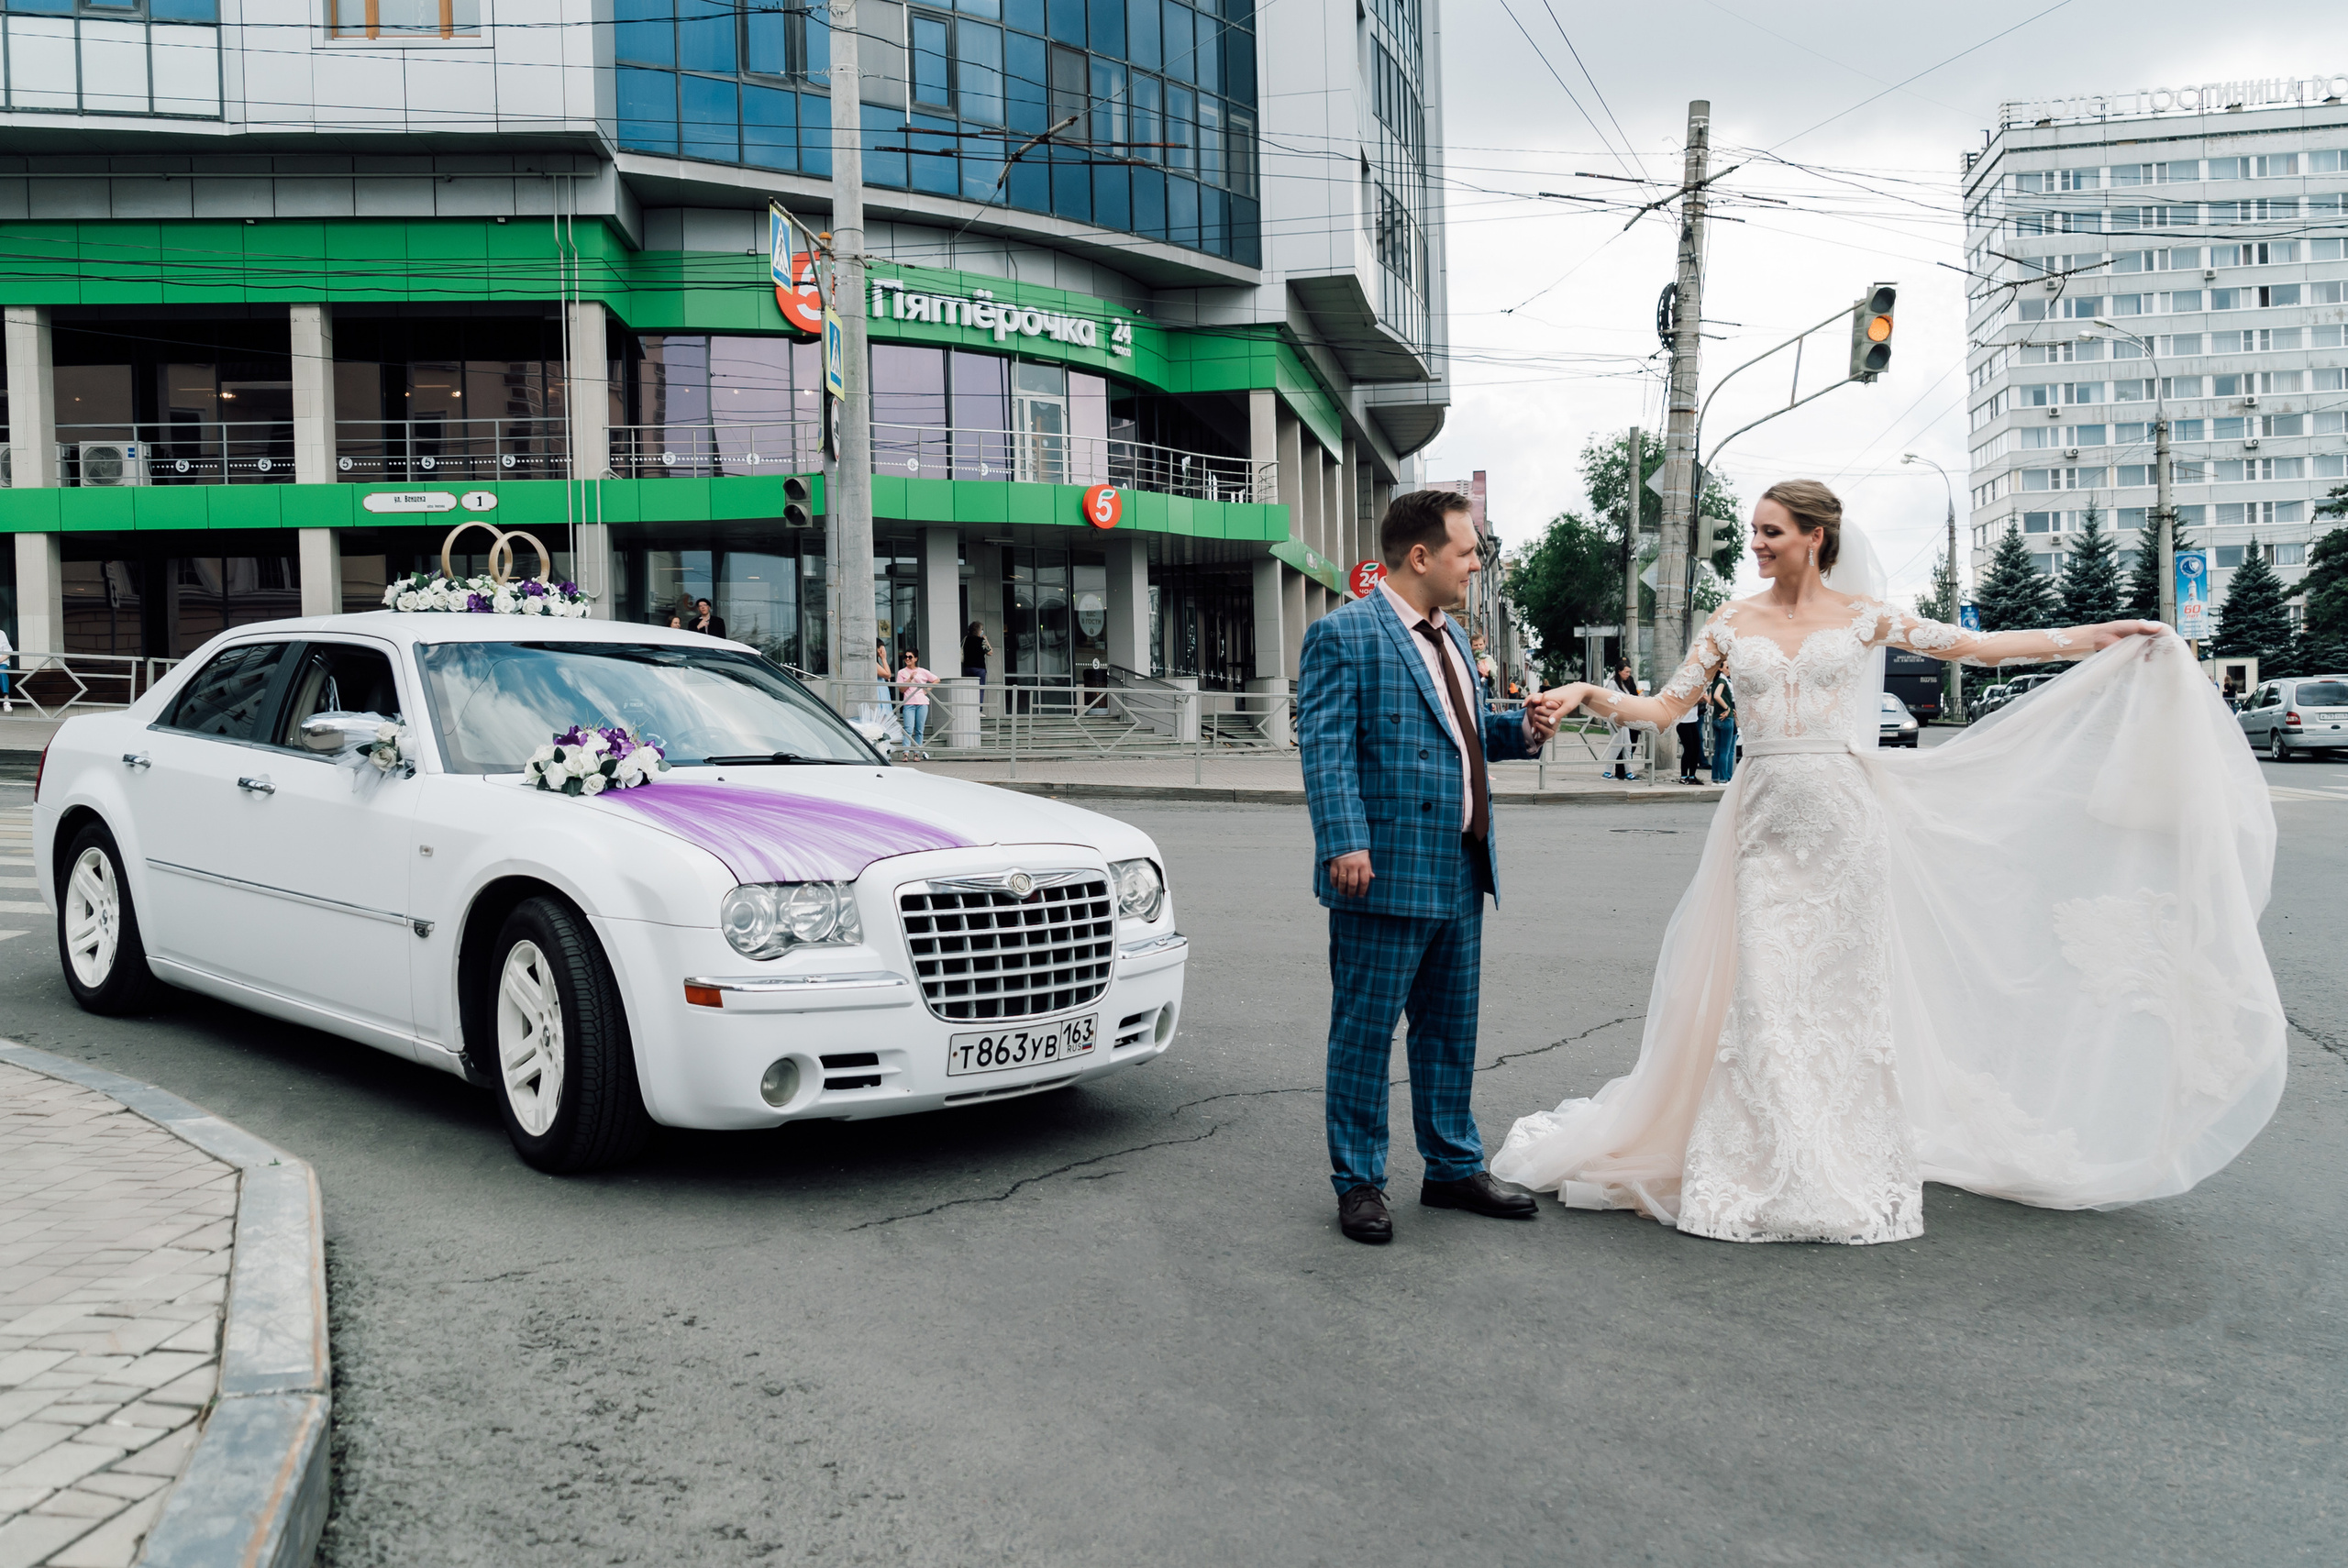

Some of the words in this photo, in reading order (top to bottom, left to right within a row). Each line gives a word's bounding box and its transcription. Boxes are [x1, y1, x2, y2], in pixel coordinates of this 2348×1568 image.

[2135, 76, 2300, 115] ГОСТИНИЦА
[871, 278, 1097, 348] Пятёрочка
[1111, 317, 1133, 345] 24
[476, 496, 482, 507] 1
[1094, 489, 1116, 523] 5
[1359, 572, 1379, 588] 24
[2183, 604, 2201, 614] 60
[959, 1032, 1058, 1069] Т863УВ
[1062, 1018, 1092, 1045] 163
[1067, 1043, 1082, 1054] RUS
